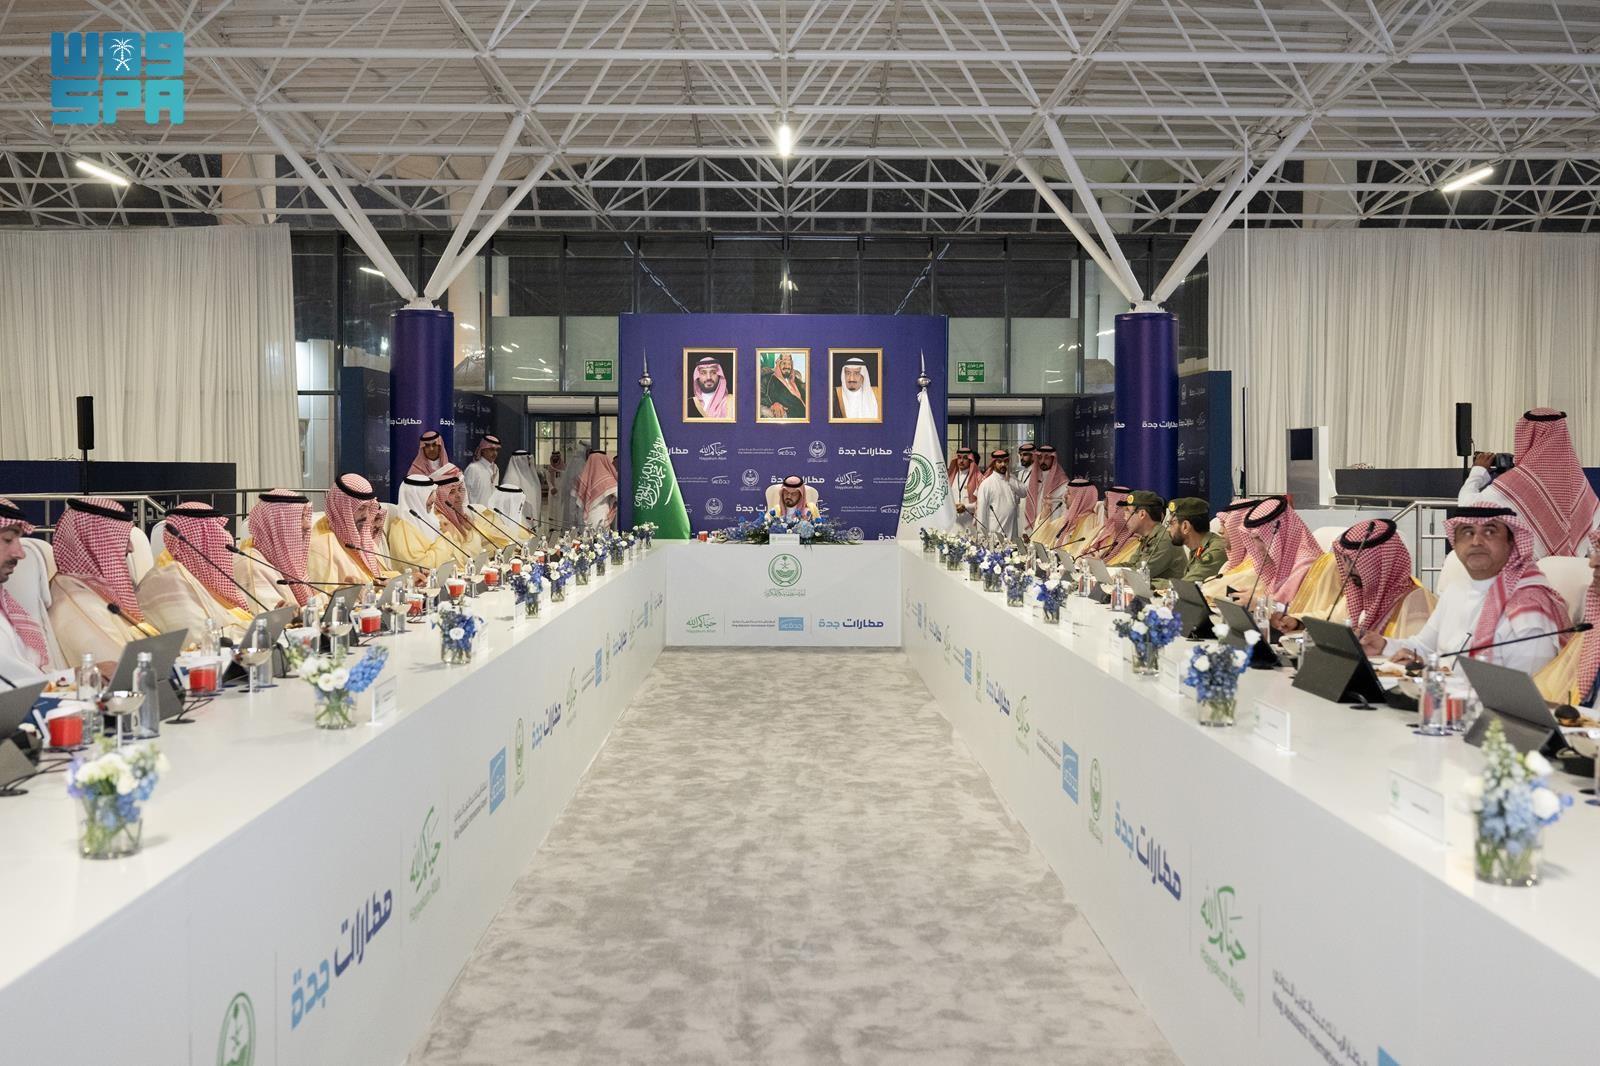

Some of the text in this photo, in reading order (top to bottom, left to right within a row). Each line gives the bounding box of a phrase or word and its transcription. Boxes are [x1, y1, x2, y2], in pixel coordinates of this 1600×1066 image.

[1142, 420, 1158, 429] جدة
[669, 447, 688, 456] مطار
[838, 447, 893, 457] مطارات جدة
[736, 504, 754, 514] جدة
[818, 618, 840, 630] جدة
[843, 618, 884, 630] مطارات
[1114, 800, 1182, 901] مطارات جدة
[291, 889, 393, 1031] مطارات جدة
